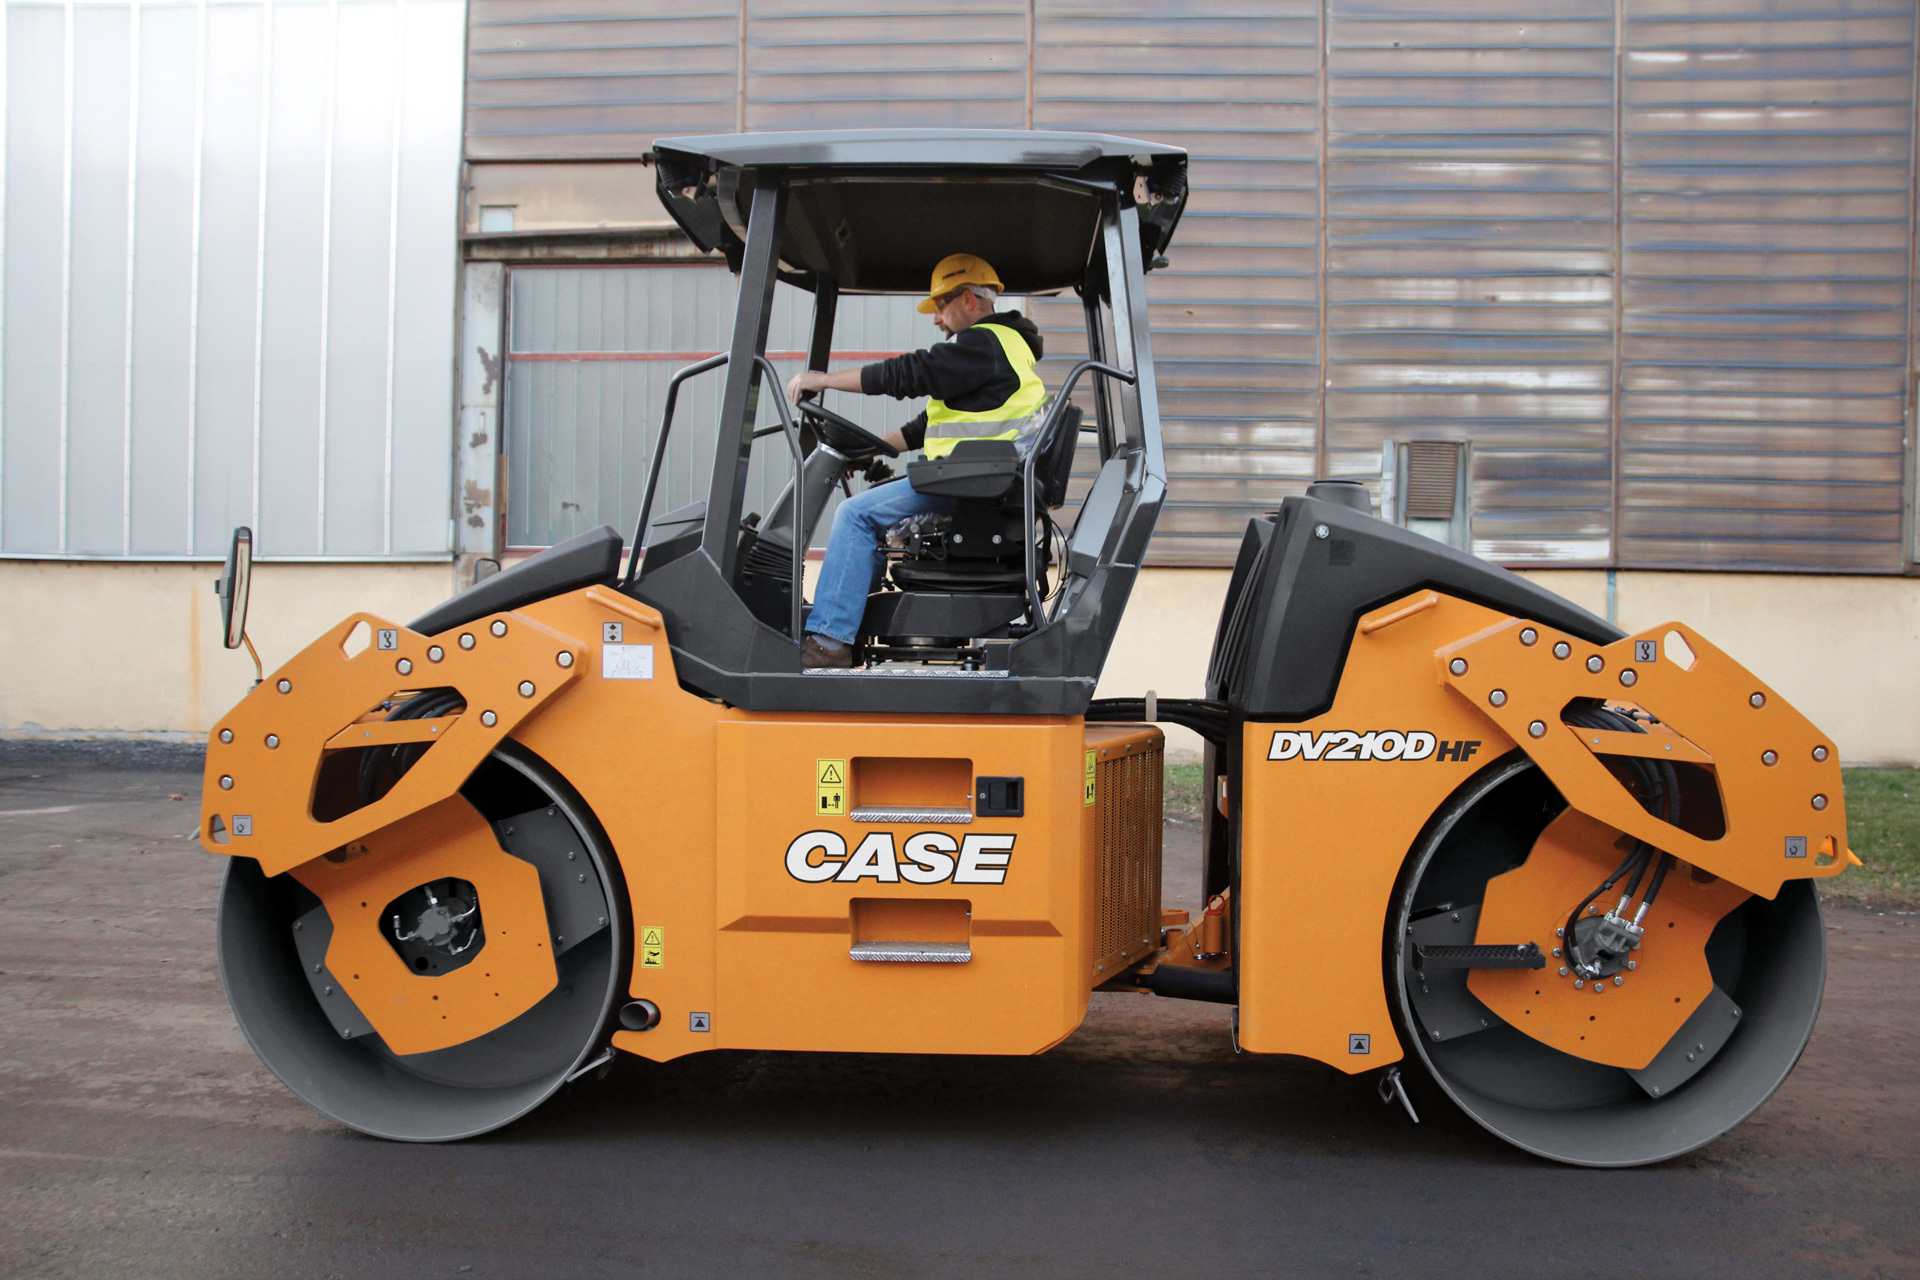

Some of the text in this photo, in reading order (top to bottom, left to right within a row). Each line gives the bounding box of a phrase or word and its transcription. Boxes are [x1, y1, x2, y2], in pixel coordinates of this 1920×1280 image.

[1267, 730, 1482, 762] DV210D HF
[784, 829, 1017, 885] CASE
